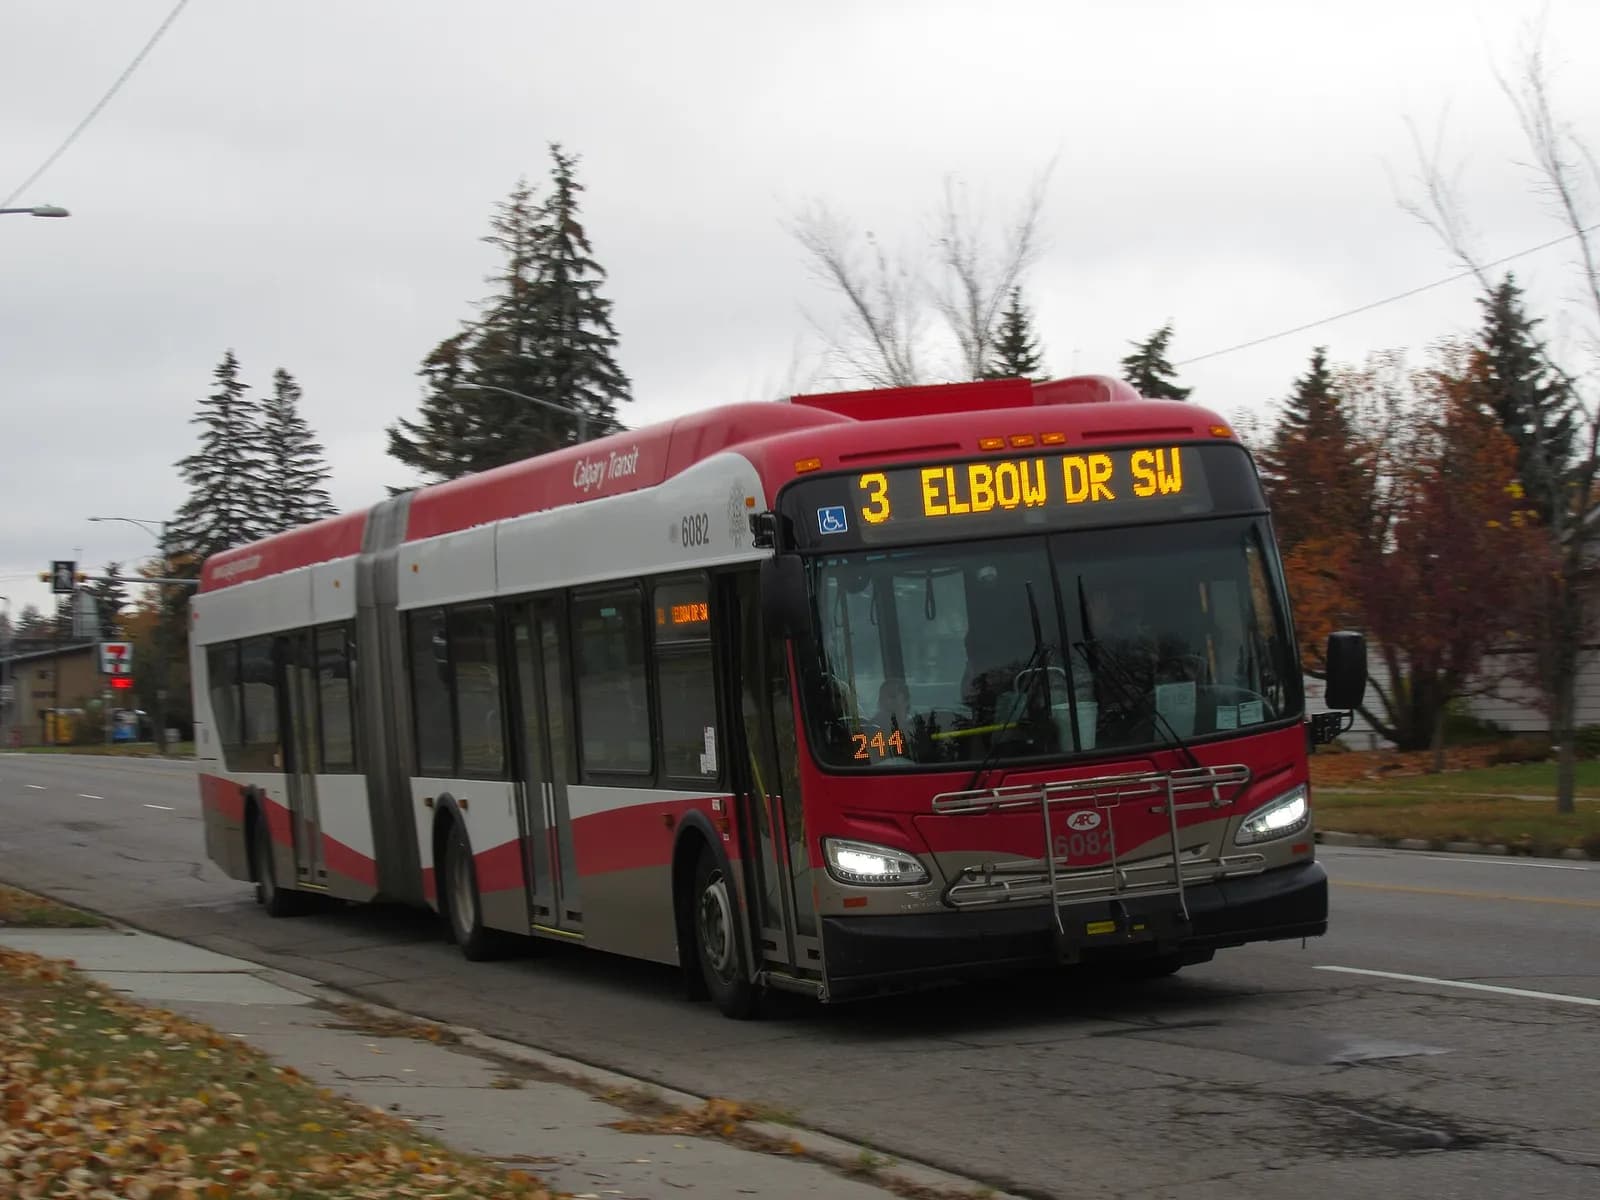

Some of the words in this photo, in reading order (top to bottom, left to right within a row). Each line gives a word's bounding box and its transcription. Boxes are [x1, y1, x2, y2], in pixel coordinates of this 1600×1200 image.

[573, 458, 607, 492] Calgary
[608, 446, 639, 480] Transit
[858, 471, 891, 524] 3
[920, 458, 1046, 517] ELBOW
[1062, 453, 1116, 504] DR
[1131, 446, 1184, 497] SW
[681, 513, 709, 547] 6082
[852, 730, 903, 759] 244
